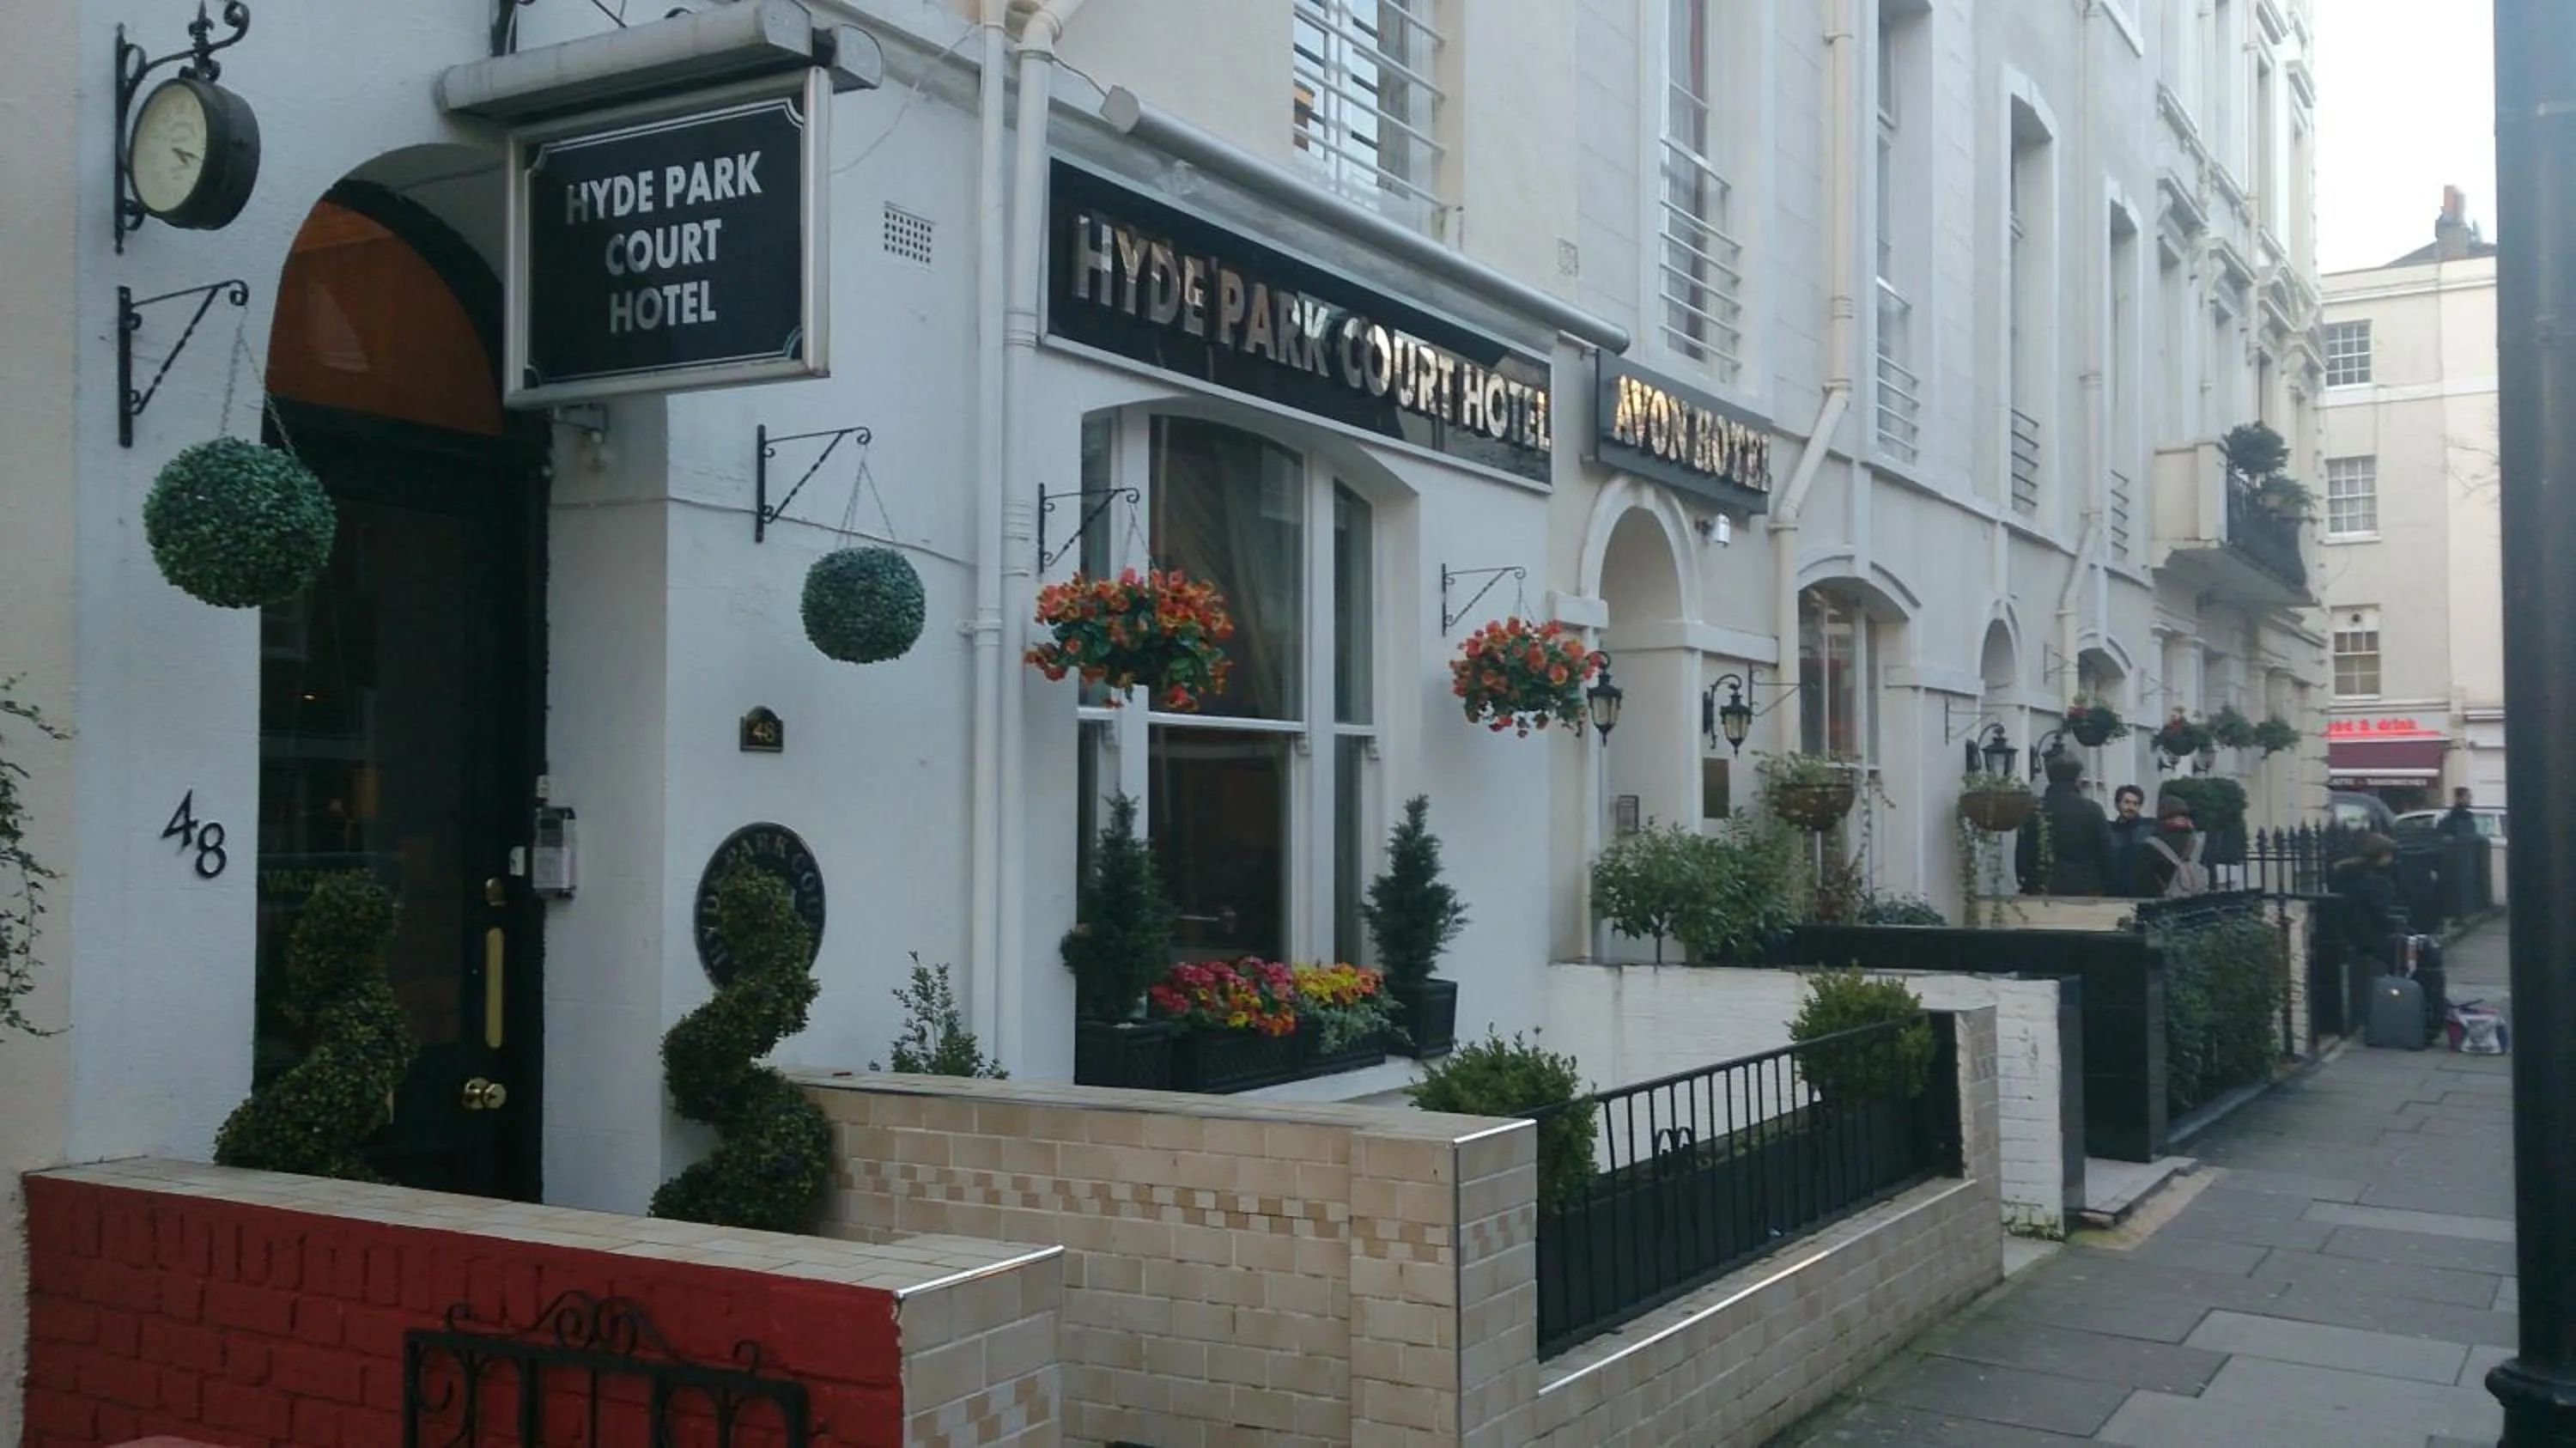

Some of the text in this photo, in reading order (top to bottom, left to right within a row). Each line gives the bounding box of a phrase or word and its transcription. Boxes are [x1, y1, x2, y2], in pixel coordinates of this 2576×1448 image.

[567, 150, 762, 224] HYDE PARK
[605, 218, 723, 277] COURT
[610, 280, 717, 334] HOTEL
[1073, 213, 1552, 453] HYDE PARK COURT HOTEL
[1613, 374, 1690, 464] AVON
[751, 720, 776, 744] 48
[160, 788, 228, 879] 48
[725, 832, 791, 867] PARK
